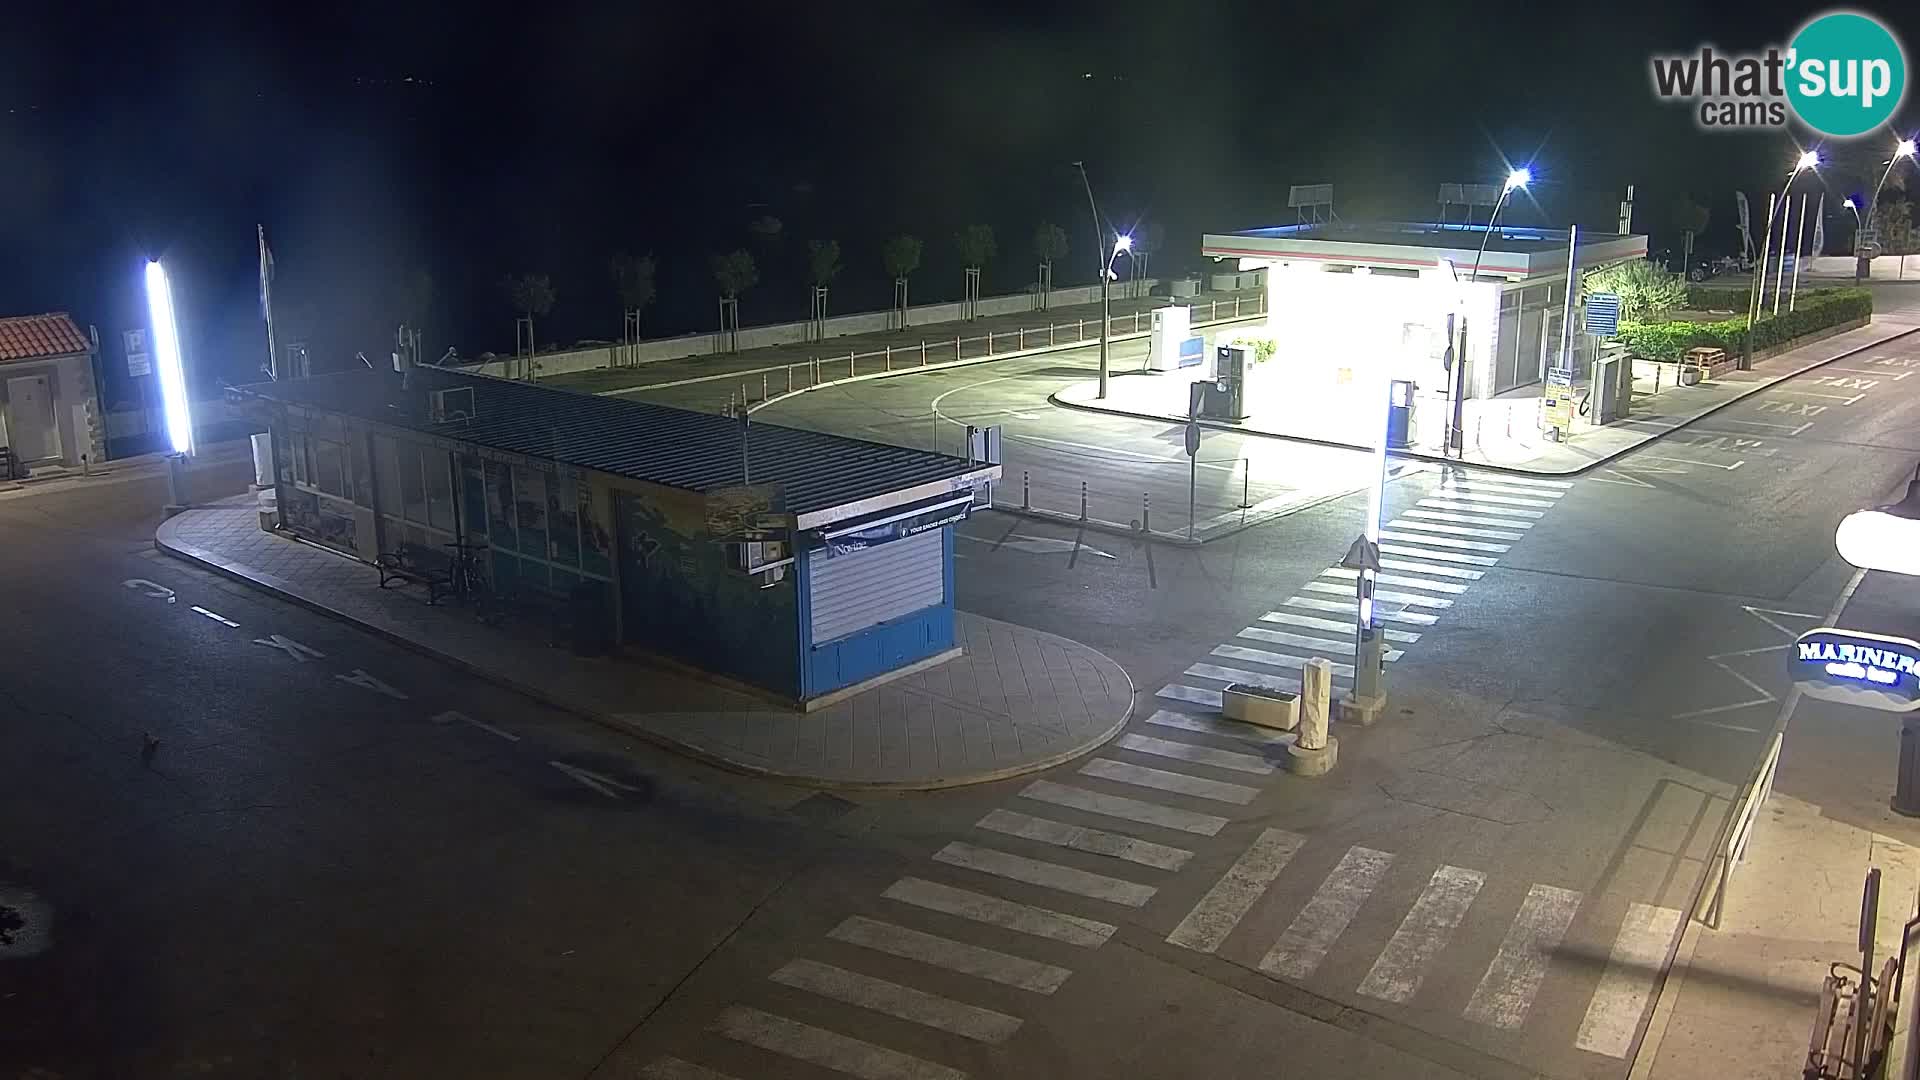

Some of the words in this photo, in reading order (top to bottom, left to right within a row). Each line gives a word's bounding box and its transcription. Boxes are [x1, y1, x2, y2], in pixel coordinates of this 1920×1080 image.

[130, 334, 141, 351] P
[1814, 376, 1880, 390] TAXI
[1756, 401, 1828, 416] TAXI
